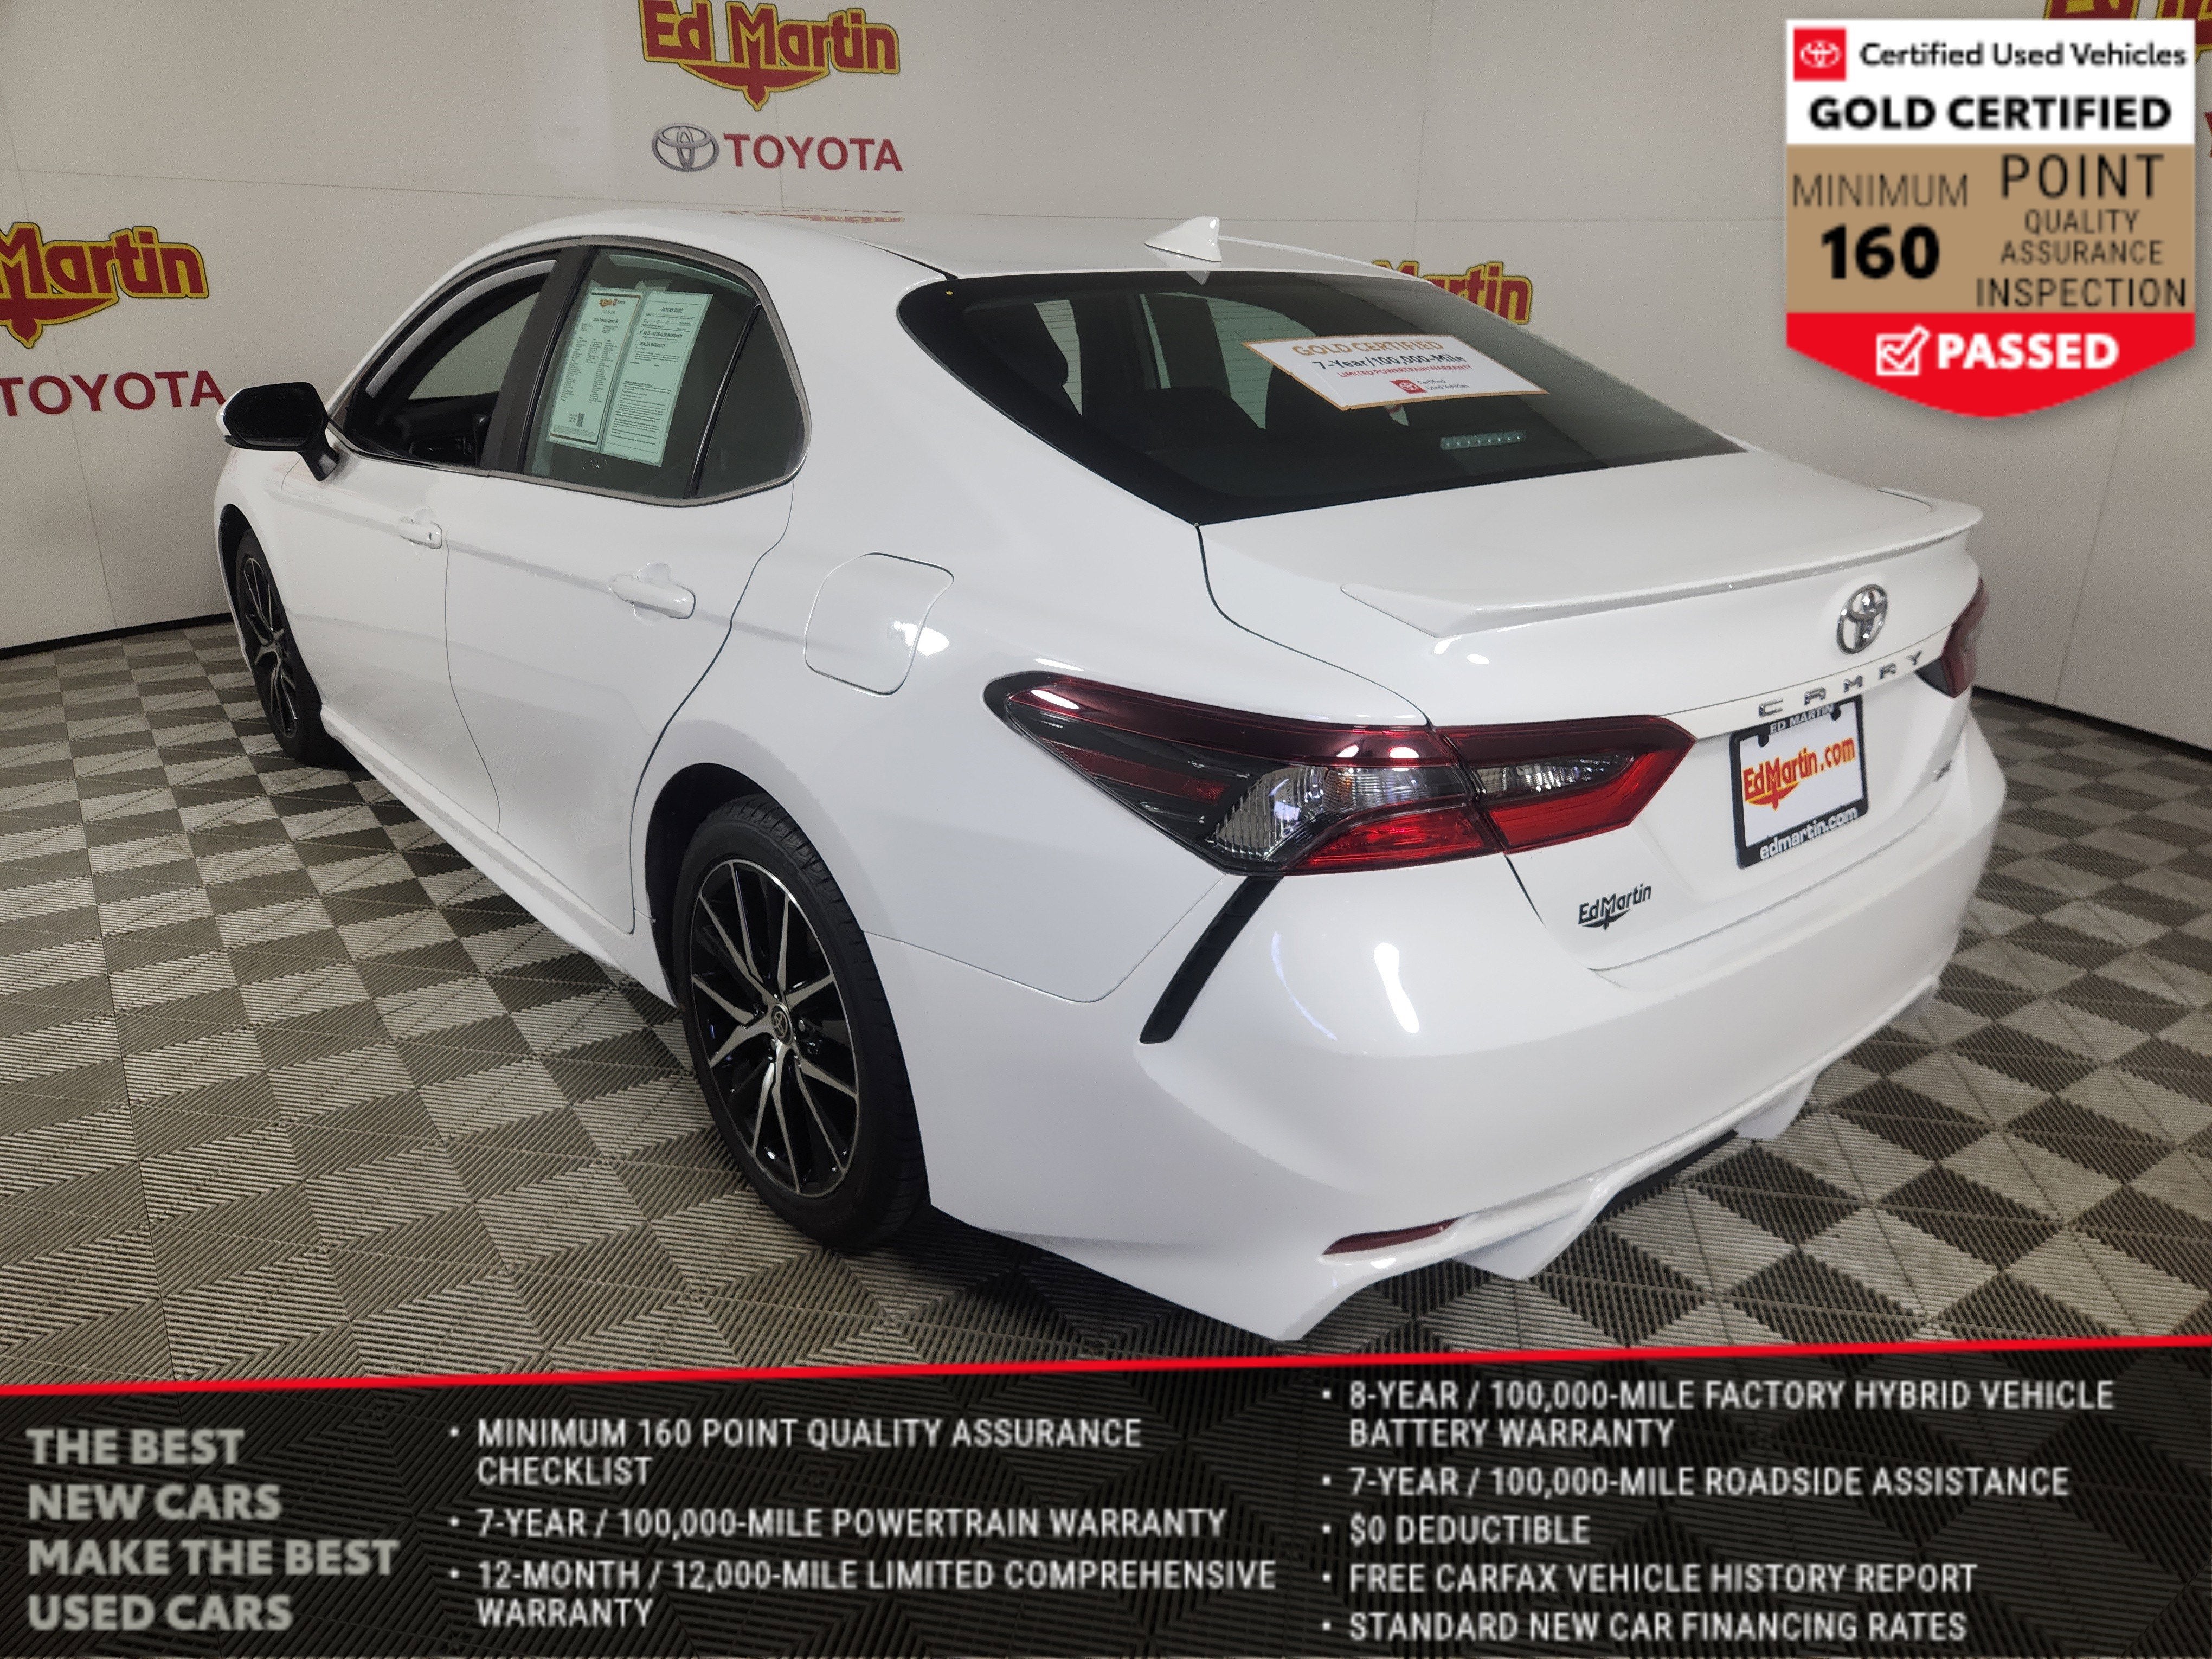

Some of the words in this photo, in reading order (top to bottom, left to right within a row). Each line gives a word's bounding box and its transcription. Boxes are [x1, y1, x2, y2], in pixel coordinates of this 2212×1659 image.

[639, 0, 715, 63] Ed
[726, 1, 901, 75] Martin
[723, 133, 903, 172] TOYOTA
[0, 222, 209, 298] Martin
[1373, 260, 1532, 325] rtin
[1292, 343, 1353, 356] GOLD
[1351, 340, 1444, 352] CERTIFIED
[1312, 353, 1467, 370] 7-Year/100,000-Mile
[1372, 366, 1430, 375] POWERTRAIN
[0, 370, 226, 417] TOYOTA
[1758, 650, 1922, 718] CAMRY
[1770, 720, 1786, 734] ED
[1789, 703, 1835, 728] MARTIN
[1742, 737, 1856, 800] EdMartin.com
[1759, 807, 1859, 860] edmartin.com
[1578, 883, 1652, 925] EdMartin
